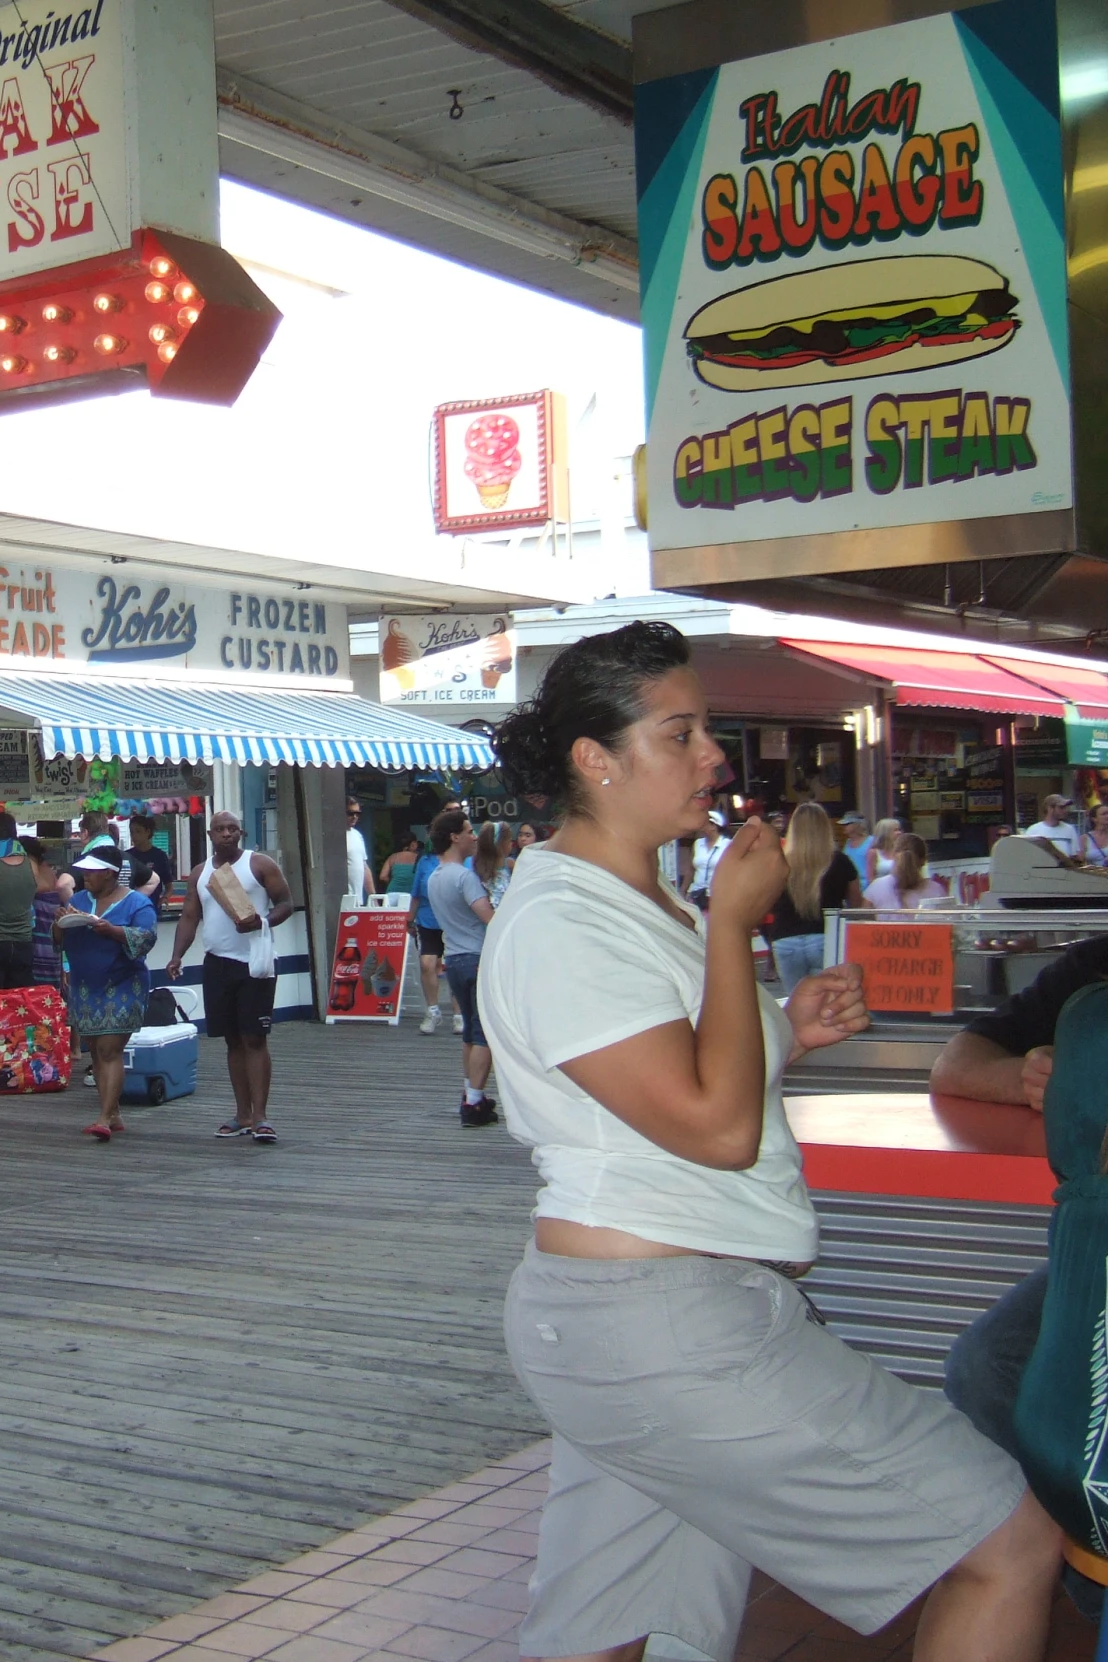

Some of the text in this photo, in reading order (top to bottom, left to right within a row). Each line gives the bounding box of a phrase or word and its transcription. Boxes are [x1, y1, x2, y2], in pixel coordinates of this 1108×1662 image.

[741, 69, 922, 164] Italian
[702, 123, 982, 272] SAUSAGE
[674, 388, 1038, 511] CHEESE STEAK
[81, 576, 198, 652] Kohr's
[229, 594, 327, 635] FROZEN
[419, 620, 480, 648] Kohr's
[220, 636, 339, 677] CUSTARD
[401, 690, 496, 701] SOFT ICE CREAM
[45, 760, 74, 785] twist
[125, 768, 179, 779] HOT WAFFLES
[132, 781, 144, 790] ICE
[145, 780, 169, 790] CREAM
[469, 798, 518, 817] iPod
[871, 929, 922, 948] SORRY
[877, 956, 944, 976] CHARGE
[896, 985, 941, 1004] ONLY
